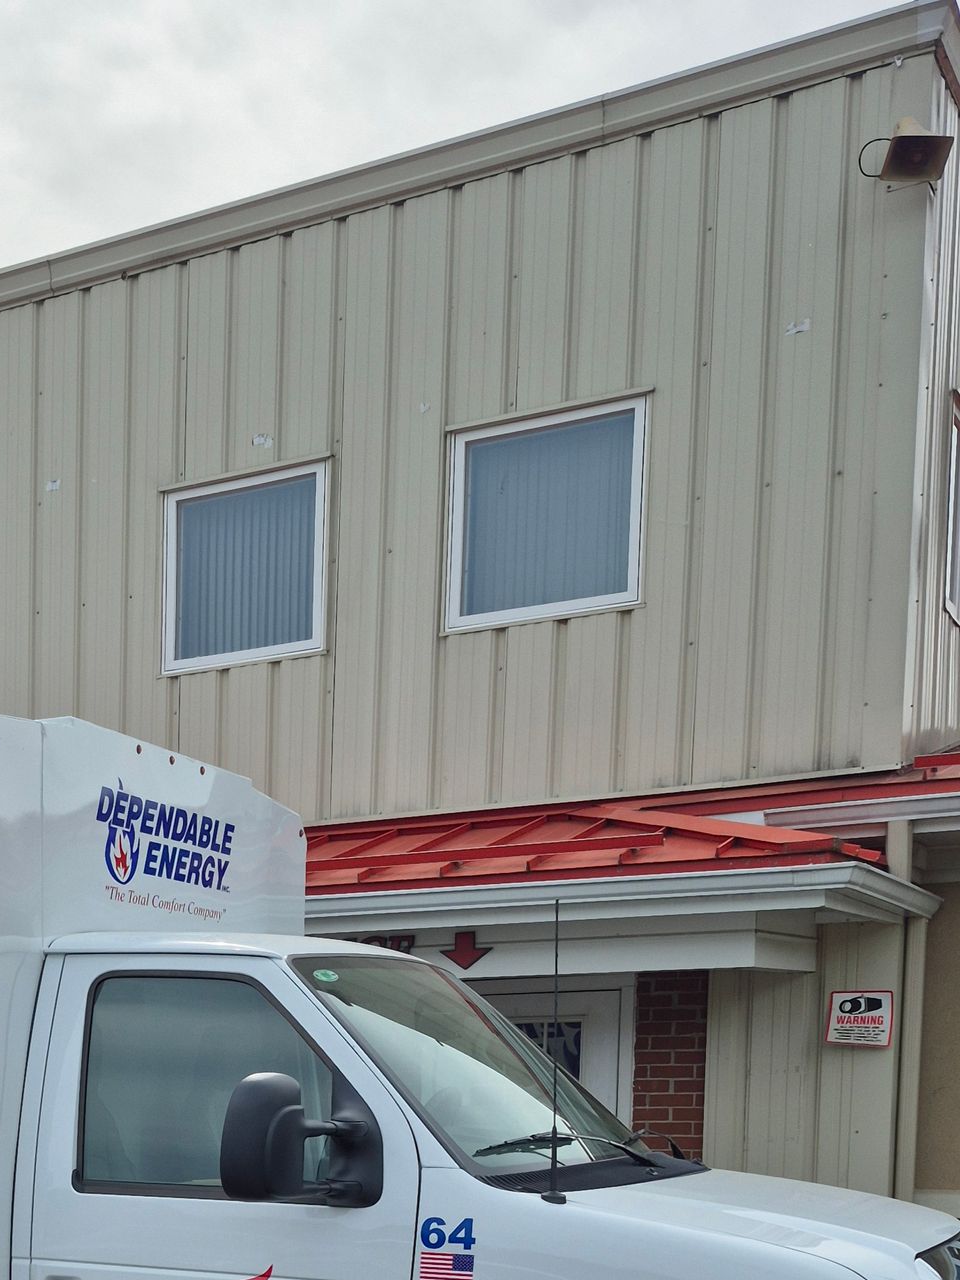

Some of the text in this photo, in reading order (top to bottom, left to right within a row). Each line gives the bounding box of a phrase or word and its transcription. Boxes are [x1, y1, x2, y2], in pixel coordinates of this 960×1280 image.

[96, 786, 236, 855] DEPENDABLE
[143, 841, 230, 891] ENERGY
[105, 885, 227, 923] "The Total Comfort Company"
[836, 1015, 884, 1025] WARNING
[420, 1216, 477, 1250] 64
